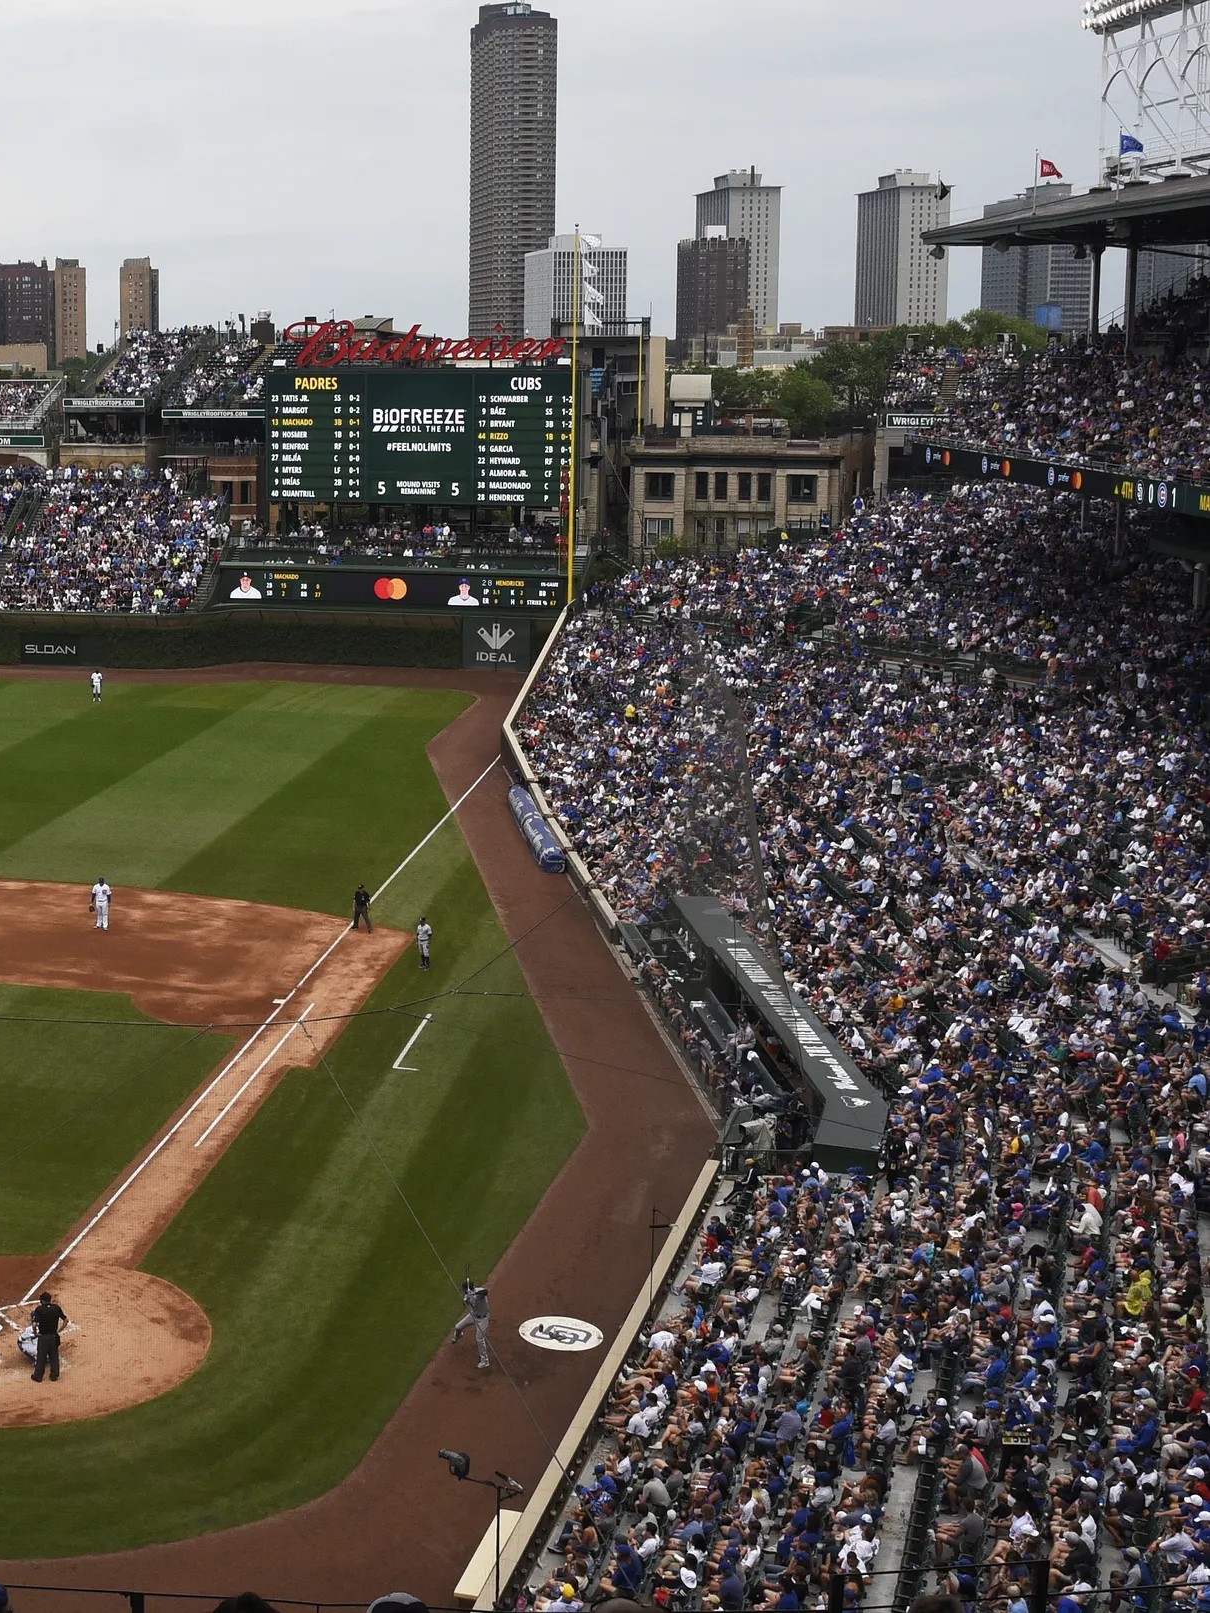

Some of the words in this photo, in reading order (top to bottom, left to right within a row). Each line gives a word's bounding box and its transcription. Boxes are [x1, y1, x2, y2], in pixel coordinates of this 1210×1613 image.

[284, 320, 566, 368] Budweiser
[296, 378, 337, 390] PADRES
[511, 377, 541, 390] CUBS
[1058, 474, 1070, 482] prefer
[378, 481, 386, 494] 5
[451, 483, 459, 496] 5
[1121, 481, 1133, 499] 4TH
[1149, 484, 1153, 503] 0
[1172, 488, 1176, 508] 1
[25, 644, 76, 654] SLOAN
[476, 652, 516, 663] IDEAL
